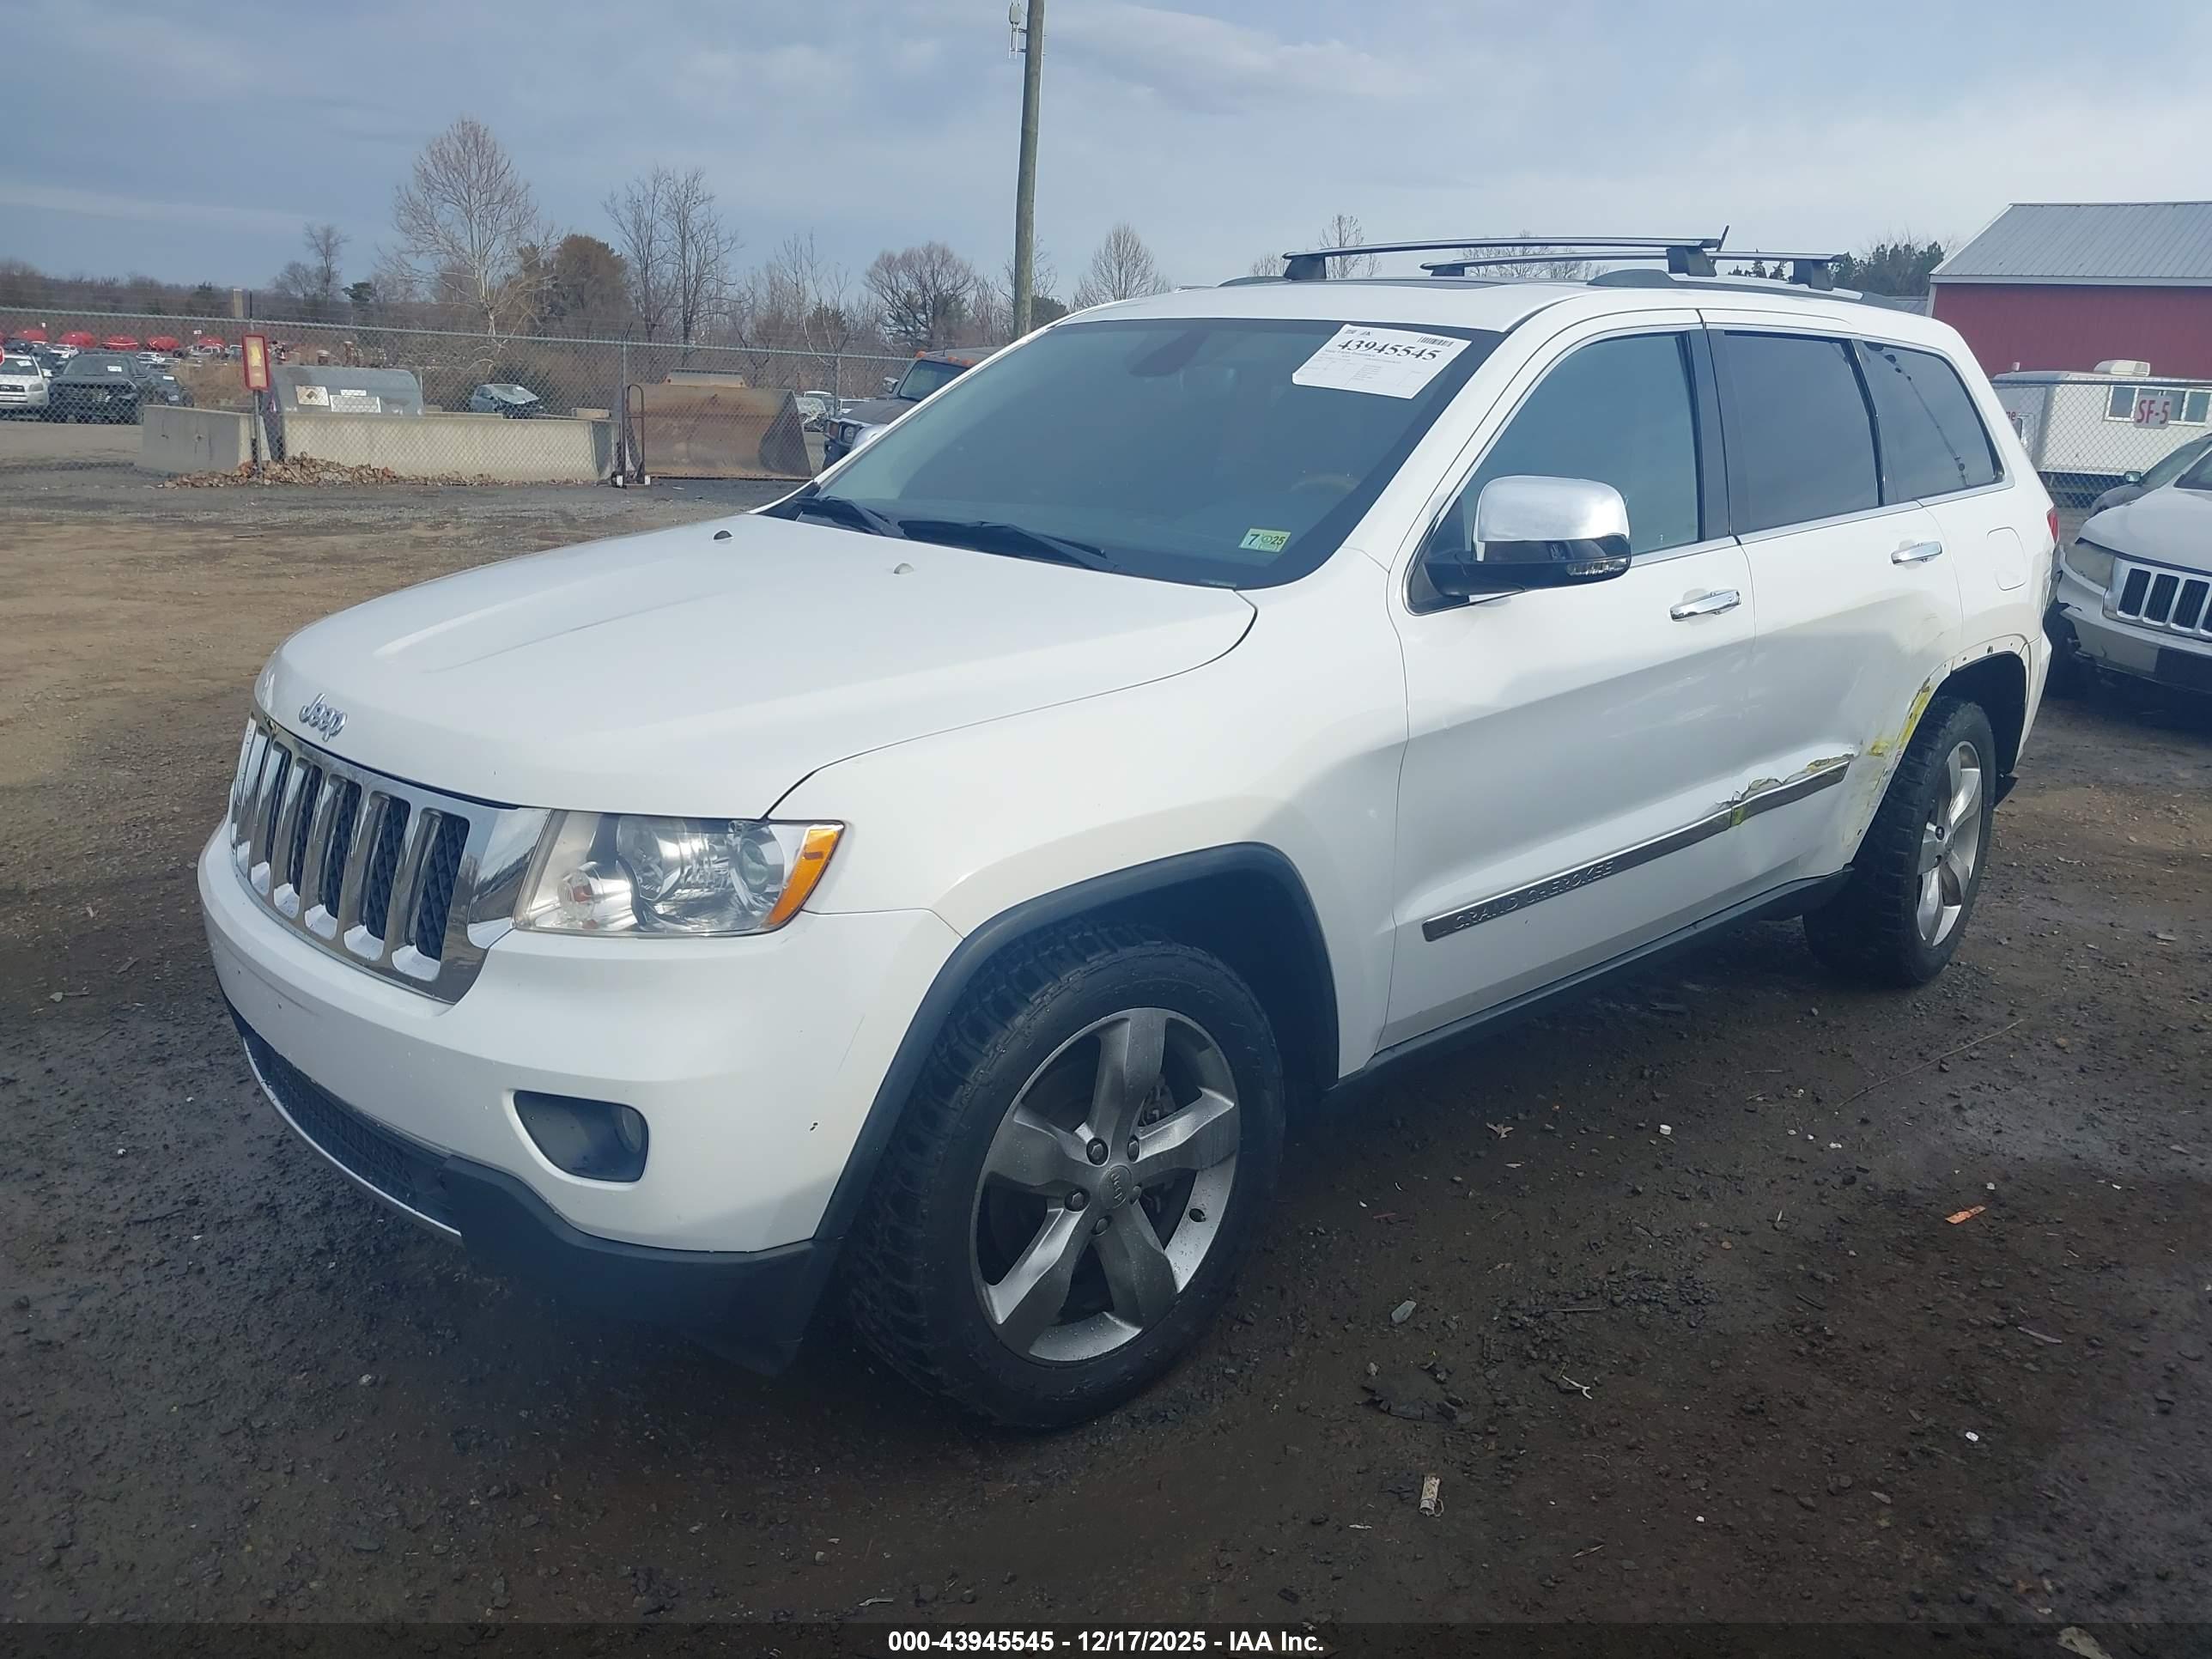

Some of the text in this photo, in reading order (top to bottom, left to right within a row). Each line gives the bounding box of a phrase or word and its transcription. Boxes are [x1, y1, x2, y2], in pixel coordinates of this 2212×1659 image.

[1338, 338, 1442, 360] 43945545
[2136, 398, 2170, 425] SF-5
[1249, 533, 1286, 545] 7 25
[299, 693, 348, 742] Jeep
[1455, 860, 1613, 928] GRAND CHEROKEE
